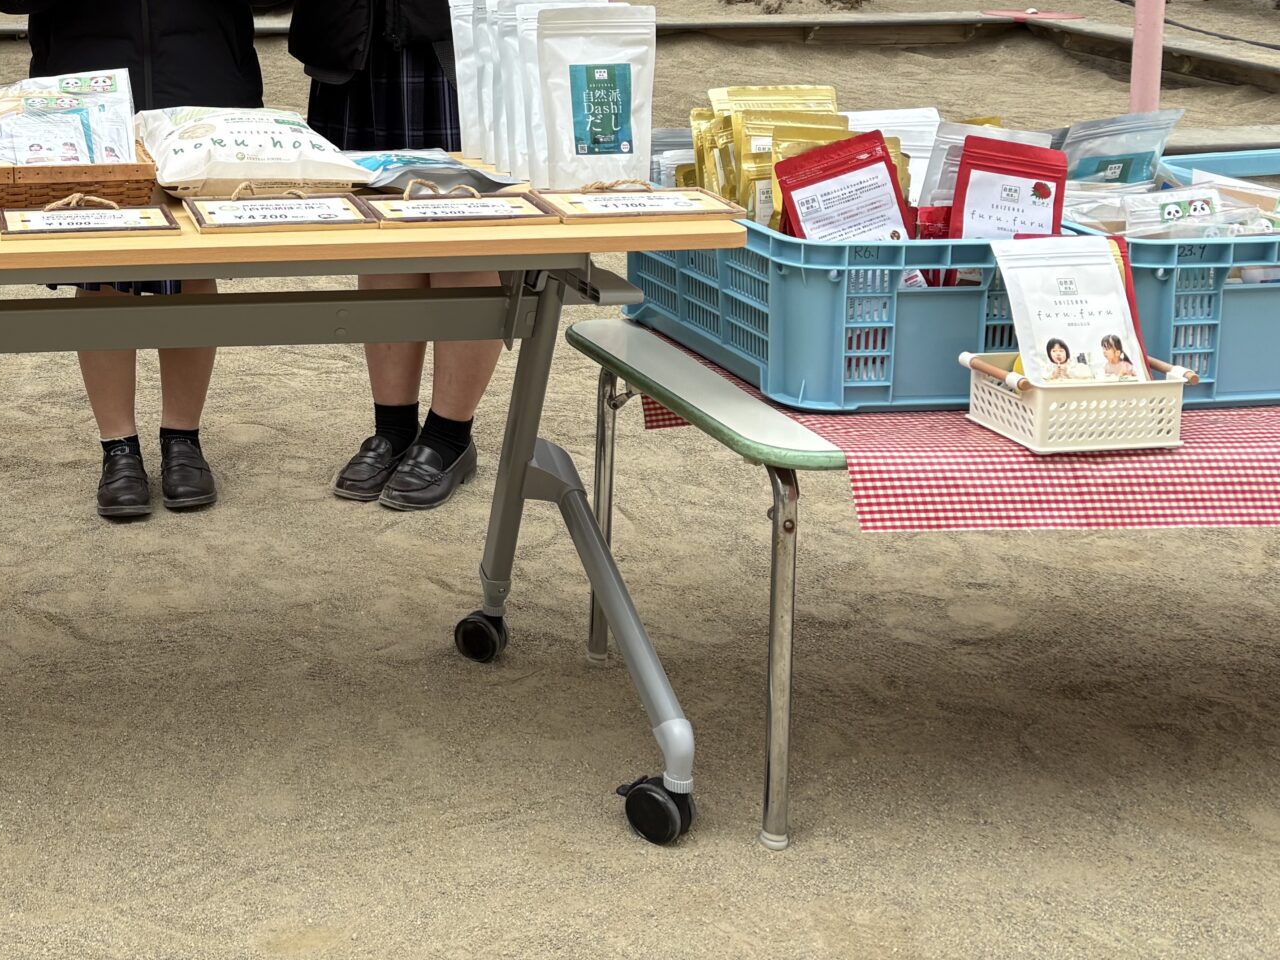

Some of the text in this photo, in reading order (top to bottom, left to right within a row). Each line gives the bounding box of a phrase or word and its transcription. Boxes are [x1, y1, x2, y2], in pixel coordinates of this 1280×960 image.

[583, 89, 621, 102] 自然派
[583, 102, 622, 114] Dashi
[586, 114, 621, 131] だし
